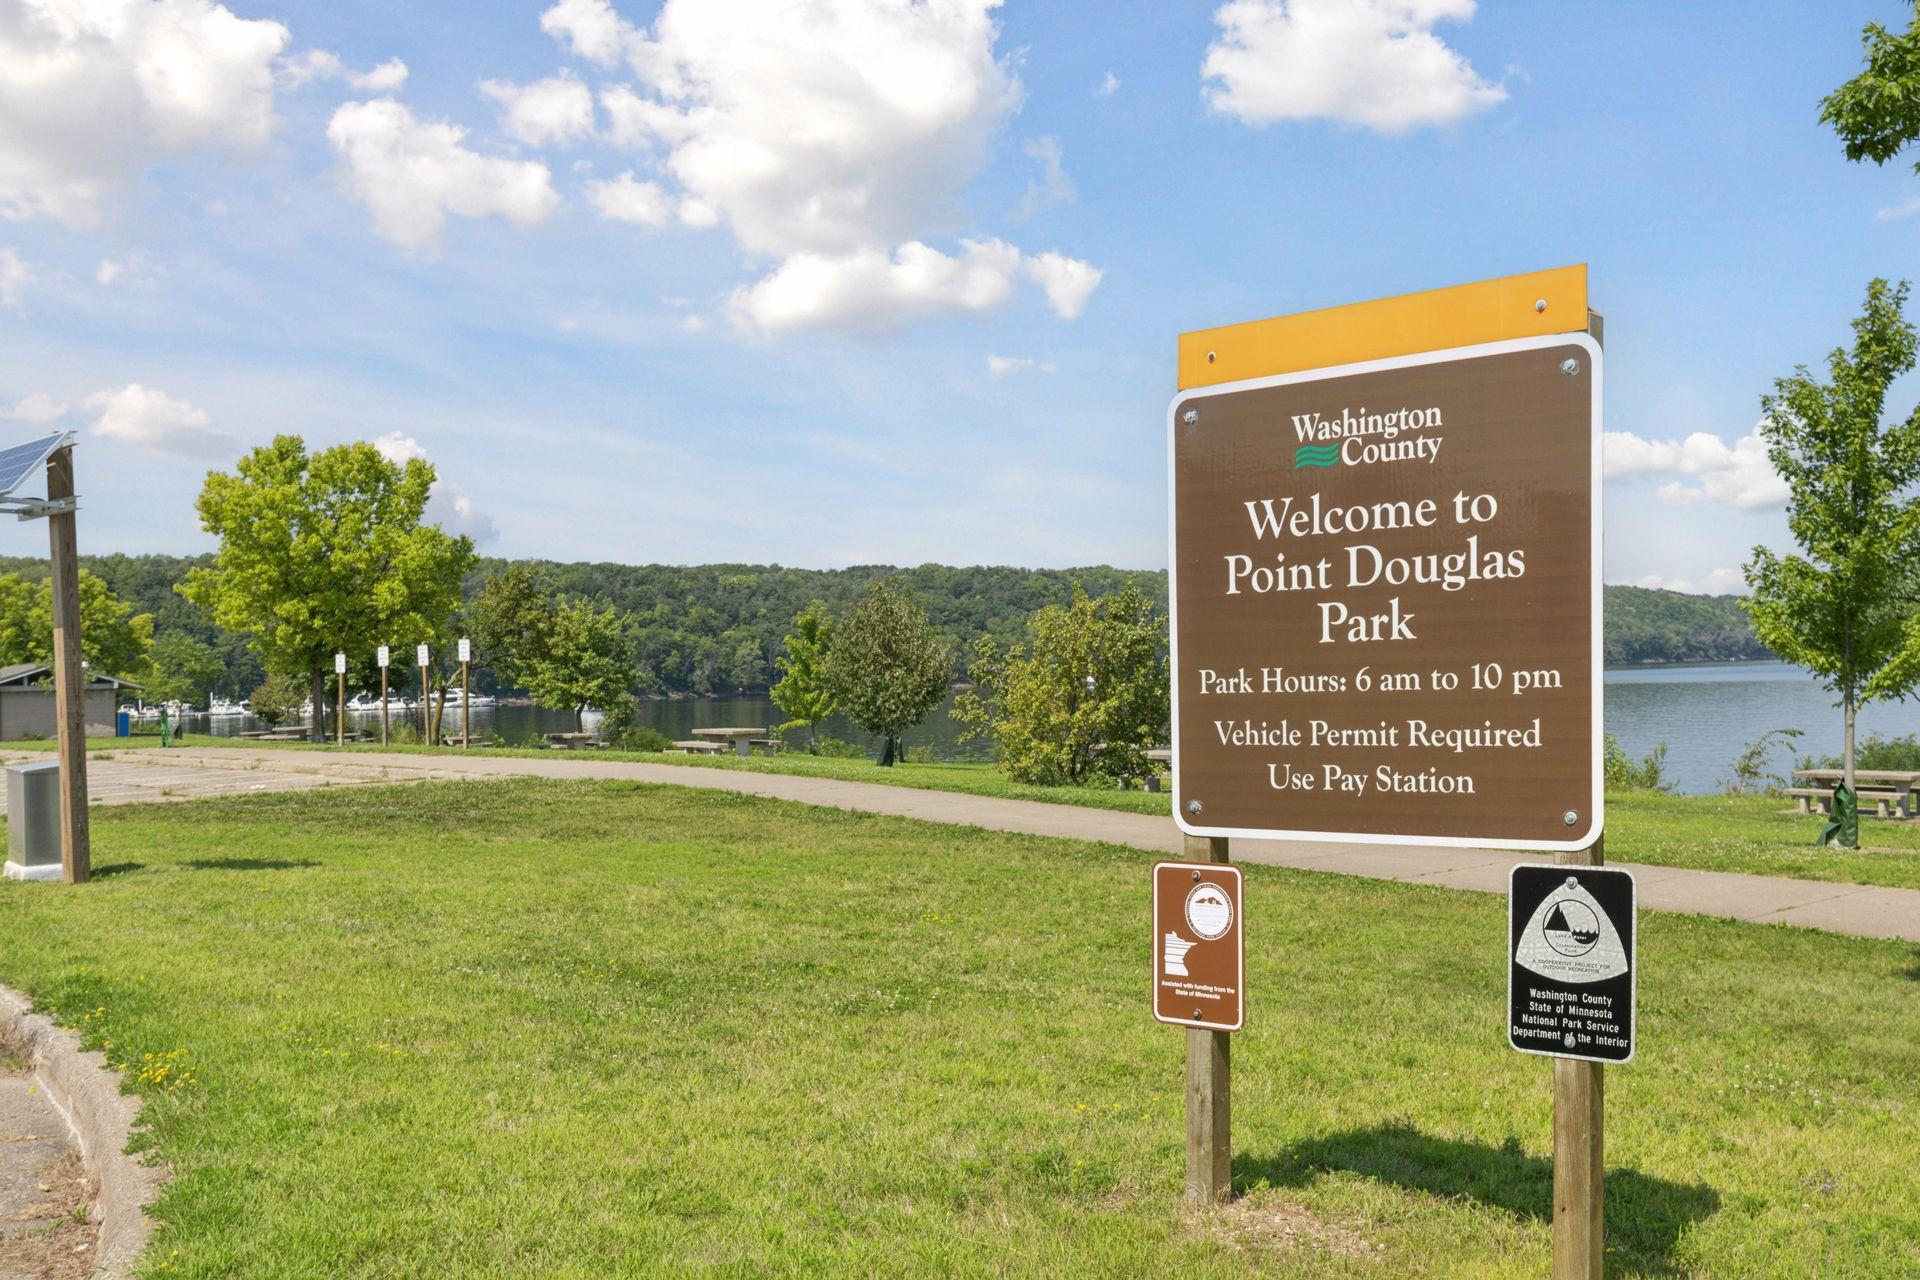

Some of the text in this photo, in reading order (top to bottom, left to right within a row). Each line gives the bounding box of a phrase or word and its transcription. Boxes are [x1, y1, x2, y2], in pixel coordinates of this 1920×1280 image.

[1291, 408, 1442, 442] Washington
[1342, 435, 1443, 465] County
[1244, 491, 1497, 539] Welcome to
[1224, 535, 1525, 594] Point Douglas
[1317, 597, 1417, 643] Park
[1199, 663, 1562, 694] Park Hours: 6 am to 10 pm
[1215, 718, 1542, 752] Vehicle Permit Required
[1268, 764, 1475, 796] Use Pay Station
[1530, 989, 1612, 1007] Washington County
[1530, 1002, 1612, 1019] State of Minnesota
[1513, 1026, 1561, 1040] Department
[1578, 1034, 1591, 1043] the
[1596, 1035, 1628, 1047] Interior
[1523, 1014, 1619, 1033] National Park Service
